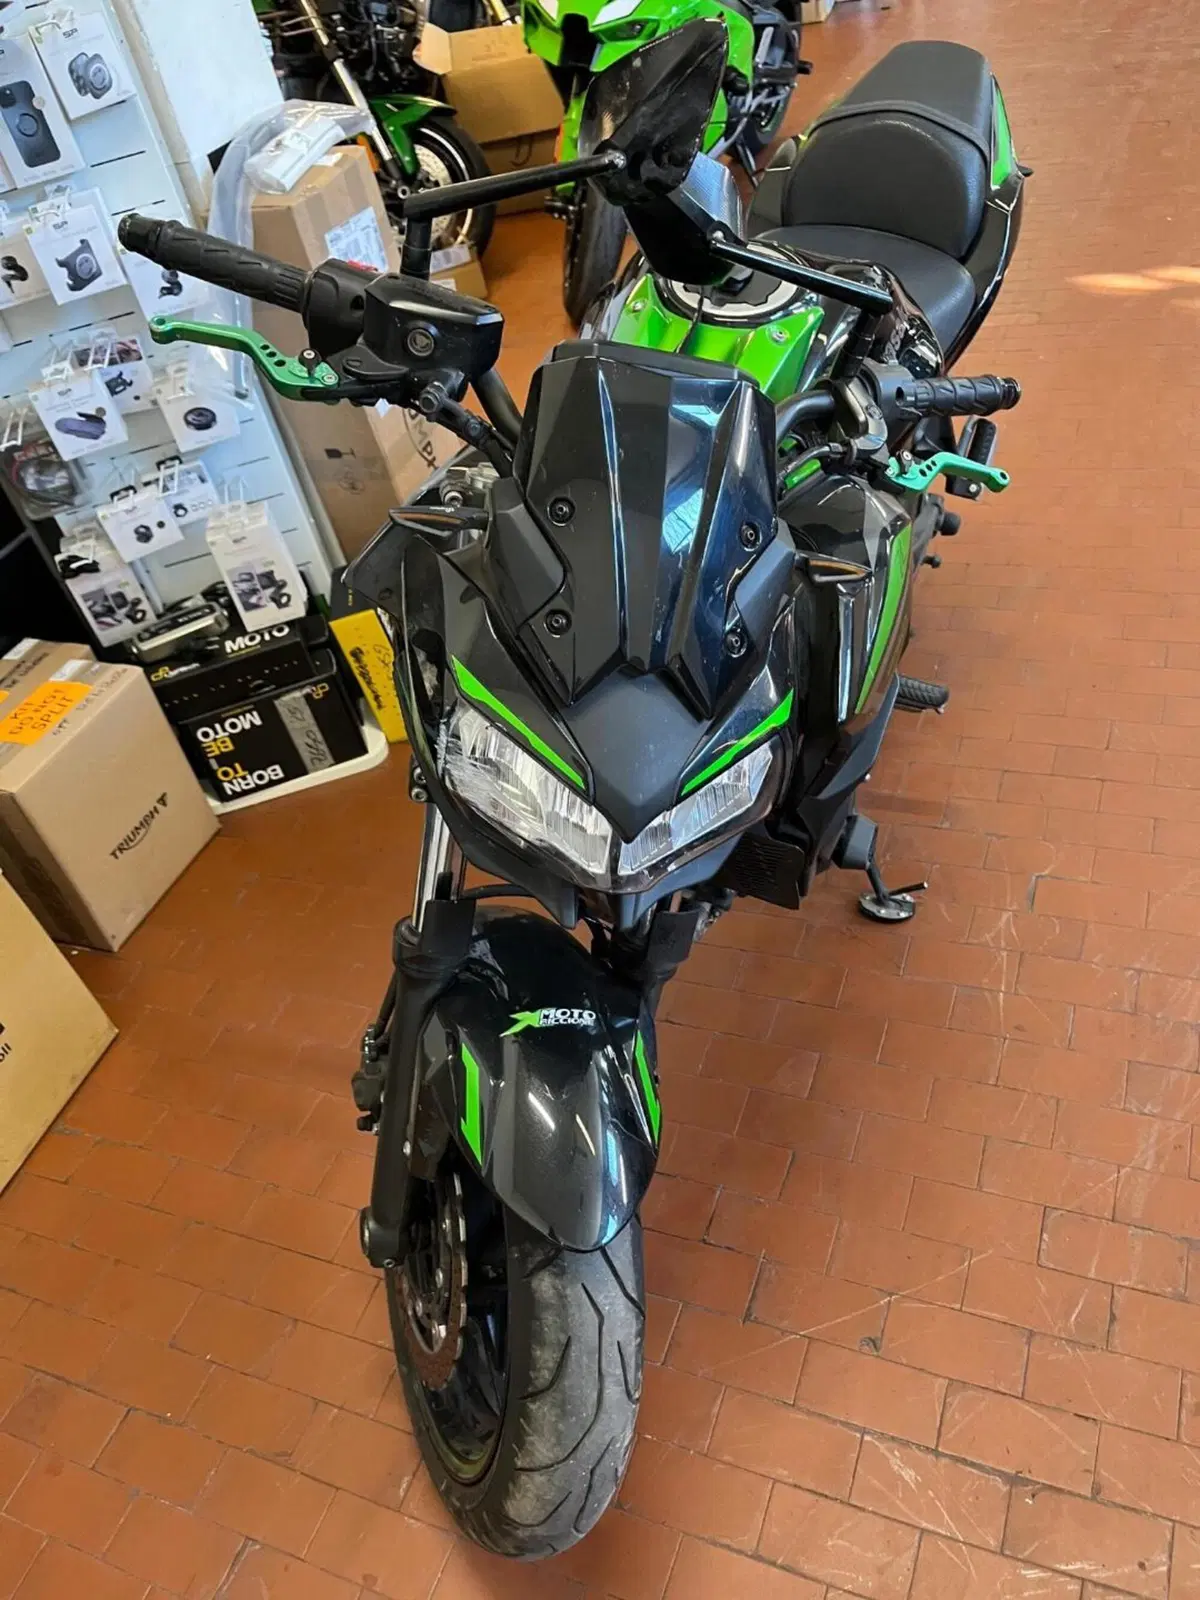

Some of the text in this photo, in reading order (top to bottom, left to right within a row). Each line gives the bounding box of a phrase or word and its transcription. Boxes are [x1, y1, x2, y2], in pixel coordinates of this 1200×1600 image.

[224, 624, 290, 654] MOTO
[30, 695, 74, 732] SPLIT
[196, 710, 263, 743] MOTO
[201, 736, 235, 758] BE
[216, 762, 249, 782] TO
[222, 763, 285, 796] BORN
[109, 805, 160, 860] TRIUMPH
[539, 1007, 597, 1021] MOTO
